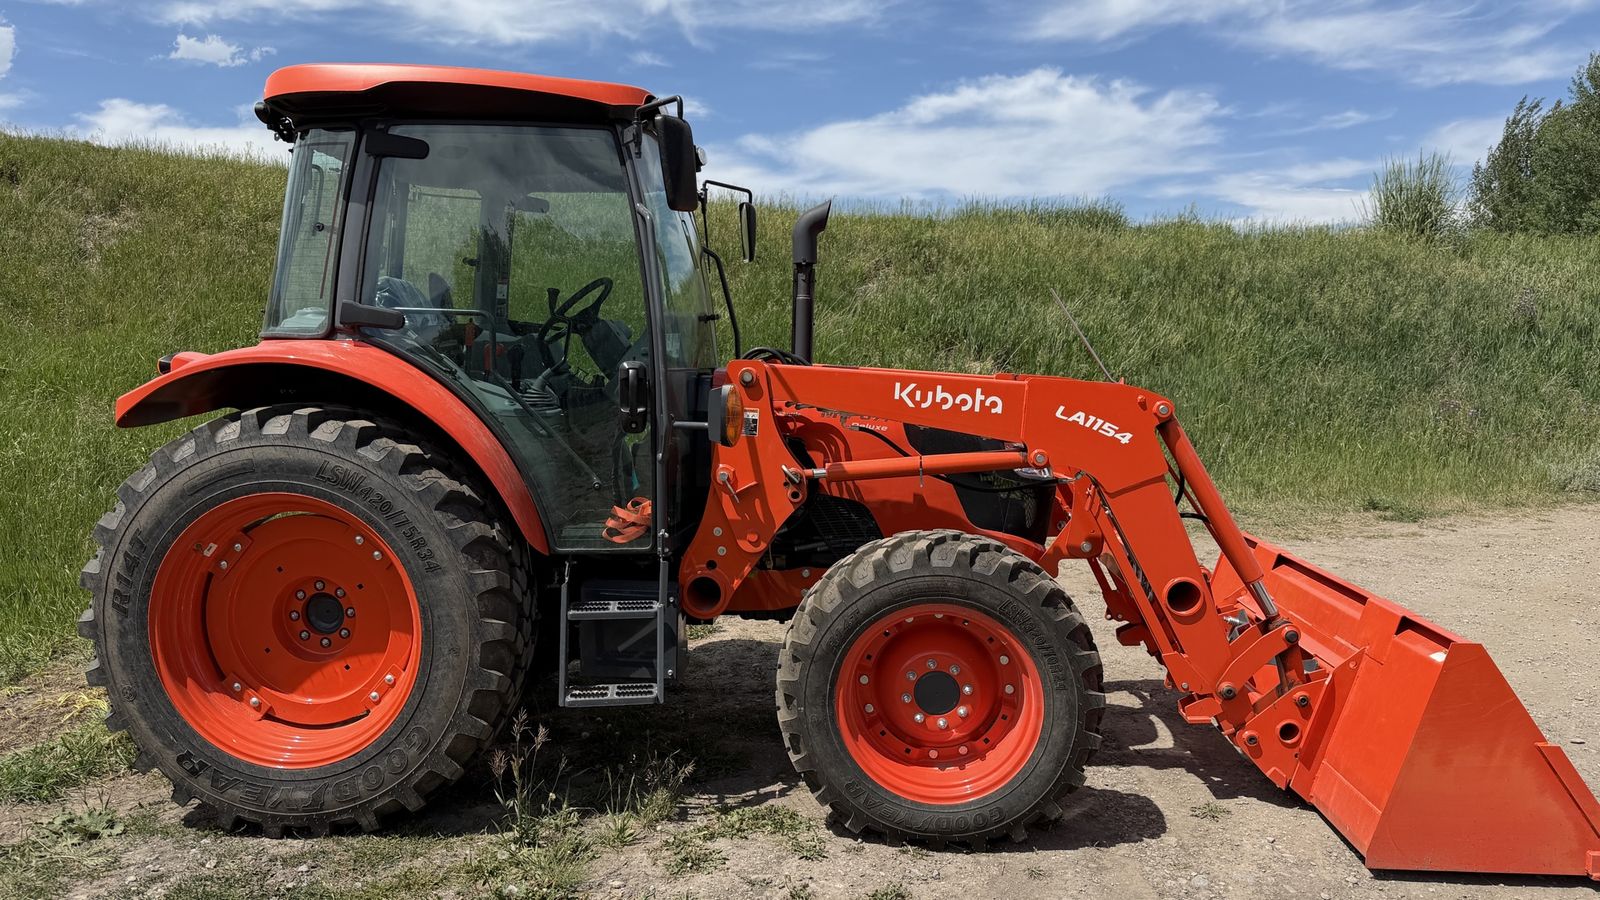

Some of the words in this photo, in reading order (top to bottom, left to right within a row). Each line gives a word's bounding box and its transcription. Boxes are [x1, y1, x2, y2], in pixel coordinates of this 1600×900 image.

[894, 382, 1003, 414] Kubota
[1055, 405, 1134, 444] LA1154
[111, 527, 147, 618] R14T
[176, 726, 431, 810] GOODYEAR
[844, 780, 1007, 831] GOODYEAR
